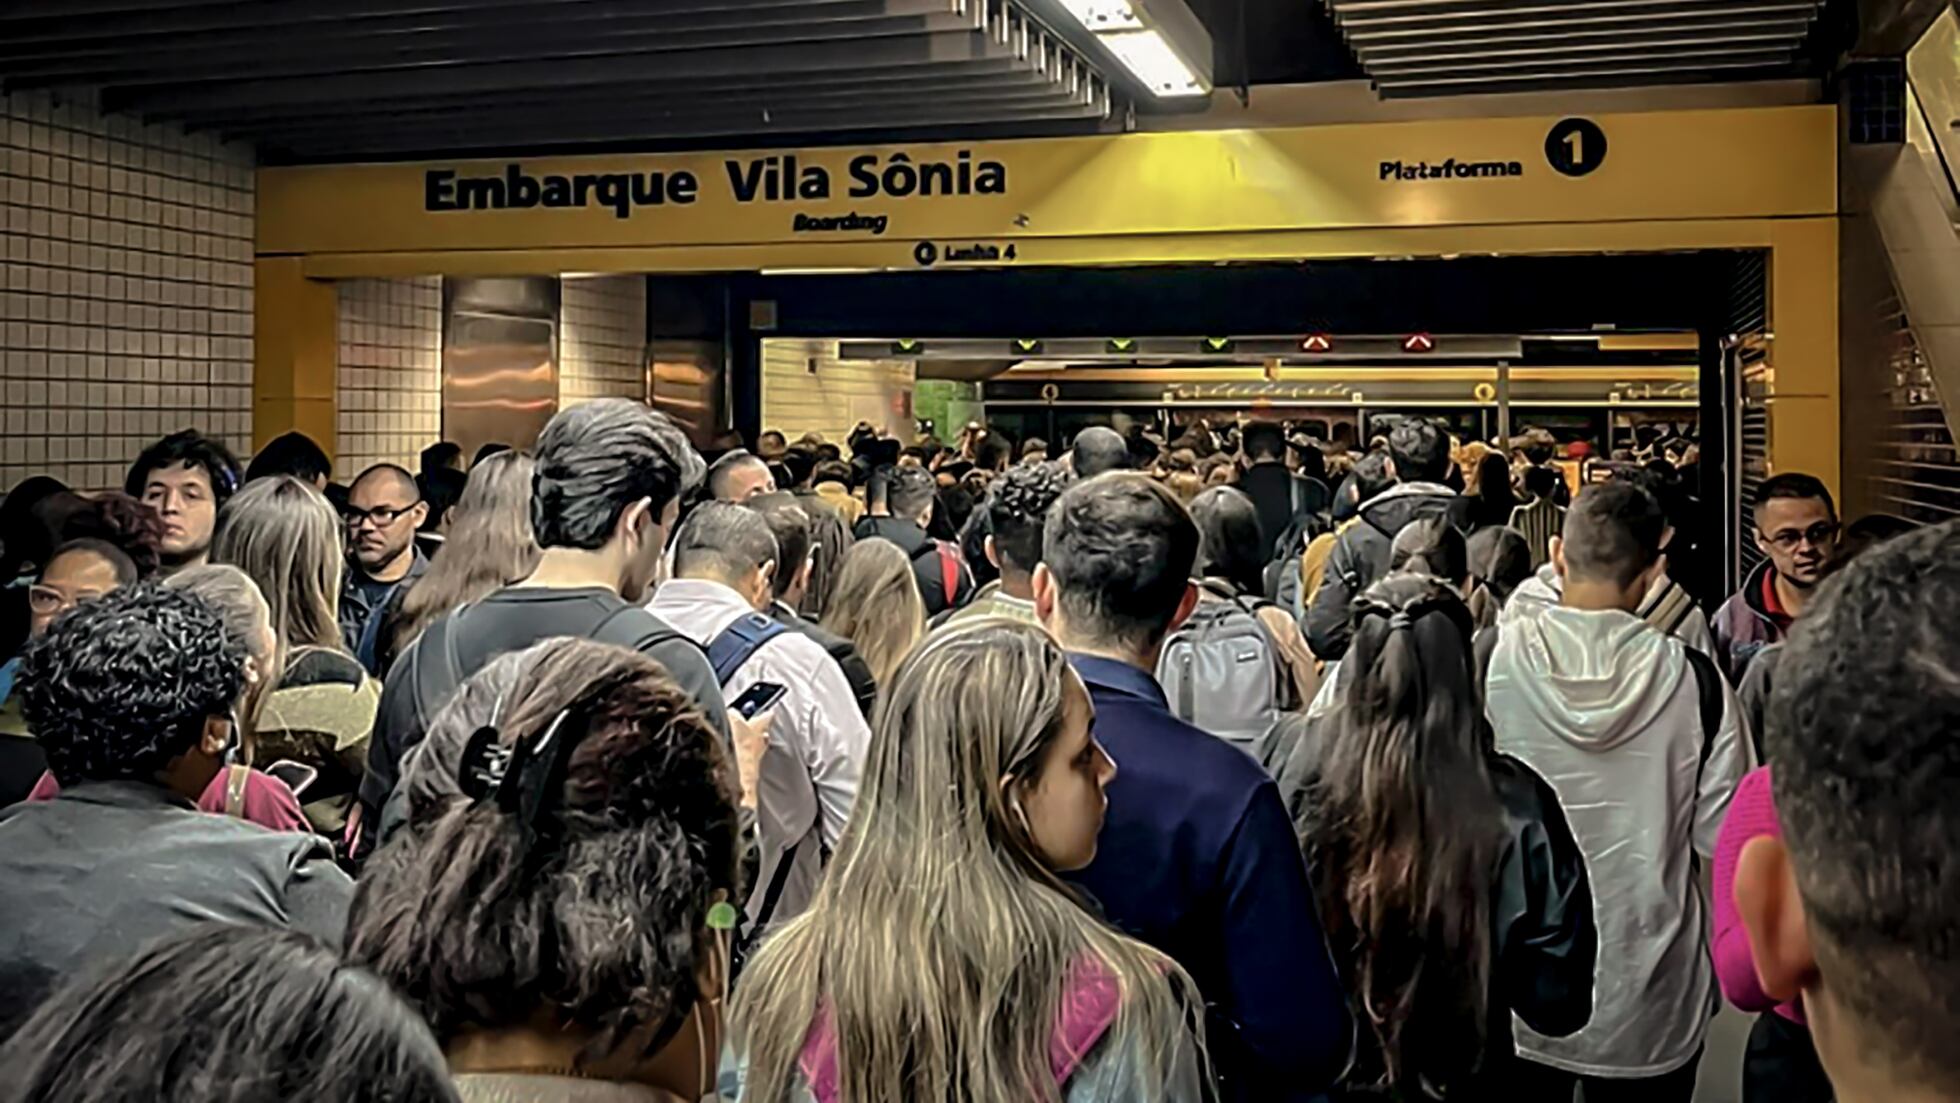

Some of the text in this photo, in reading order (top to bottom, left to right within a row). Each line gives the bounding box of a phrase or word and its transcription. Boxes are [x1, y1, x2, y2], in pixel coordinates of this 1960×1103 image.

[1380, 130, 1583, 180] Plataforma 1
[425, 150, 1005, 218] Embarque Vila Sônia
[1003, 244, 1016, 260] 4
